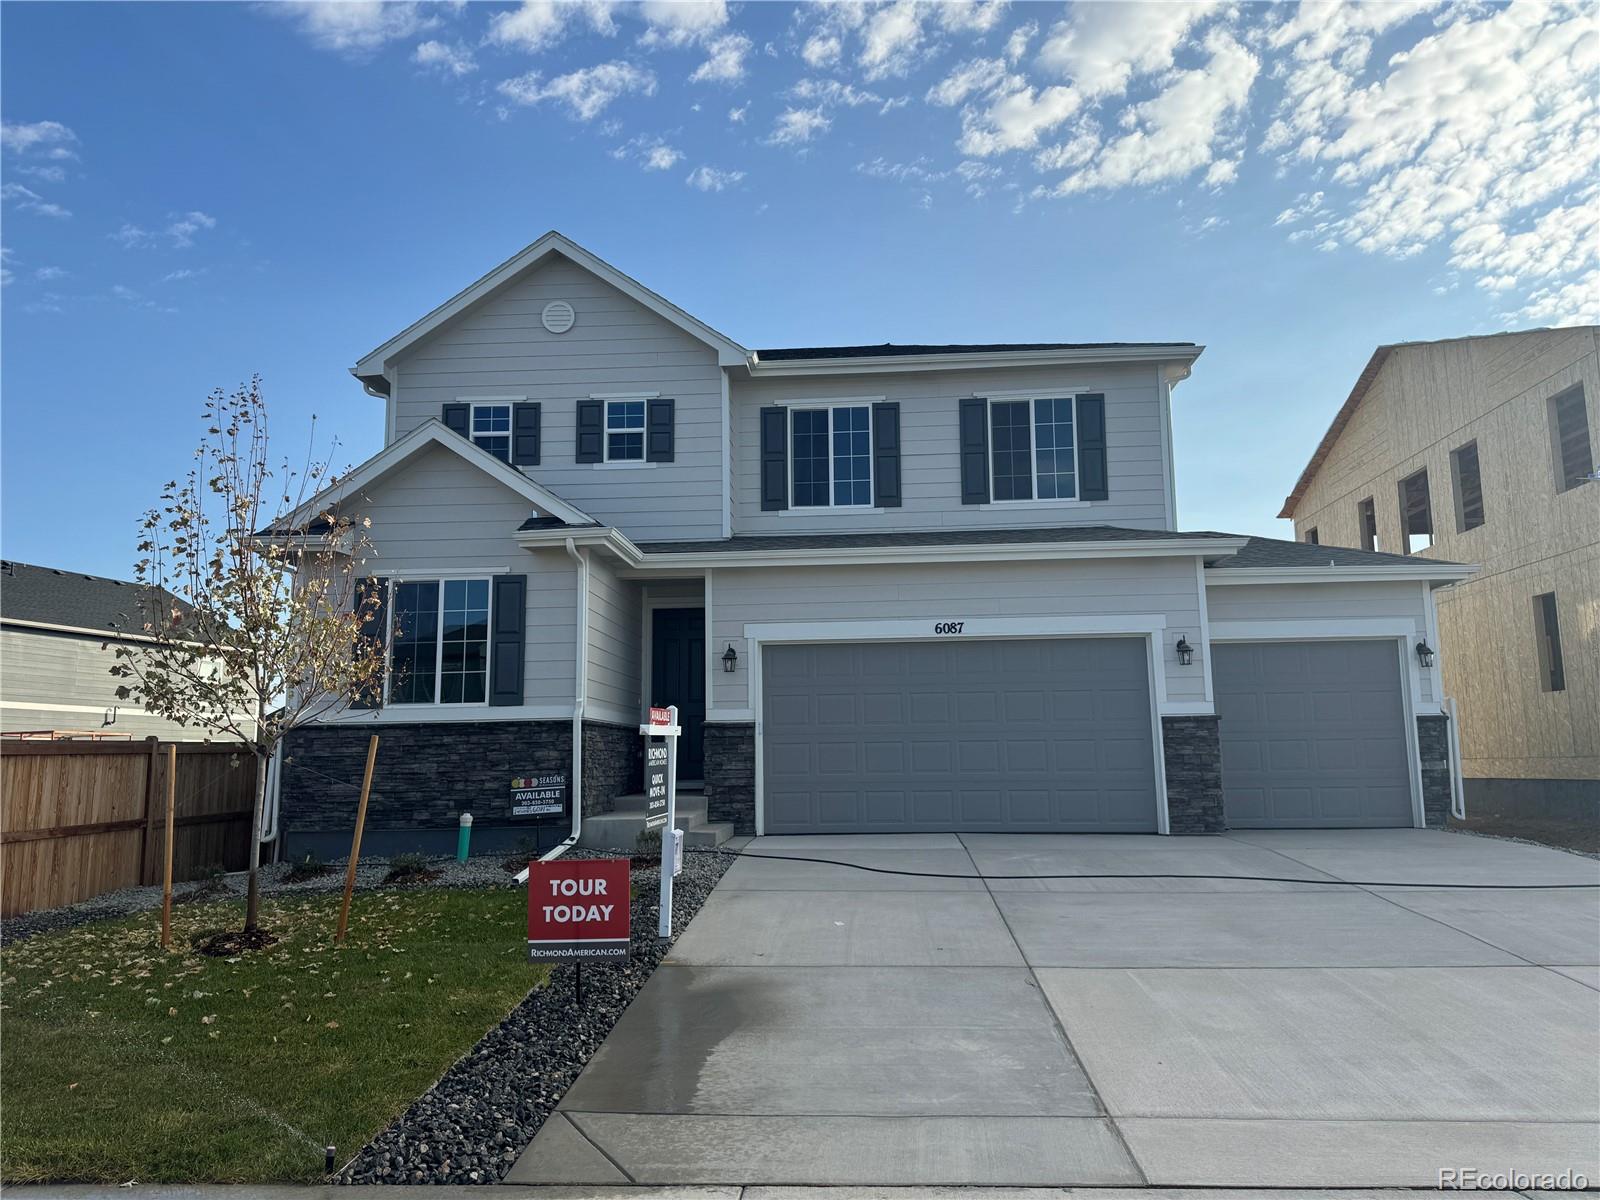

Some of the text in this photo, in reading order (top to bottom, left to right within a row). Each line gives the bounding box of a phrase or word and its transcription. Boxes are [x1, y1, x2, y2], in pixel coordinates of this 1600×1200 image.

[934, 622, 965, 635] 6087
[648, 747, 668, 760] RICHMOND
[539, 775, 565, 784] SEASONS
[651, 773, 664, 786] QUICK
[515, 790, 561, 801] AVAILABLE
[549, 878, 608, 896] TOUR
[542, 904, 615, 923] TODAY
